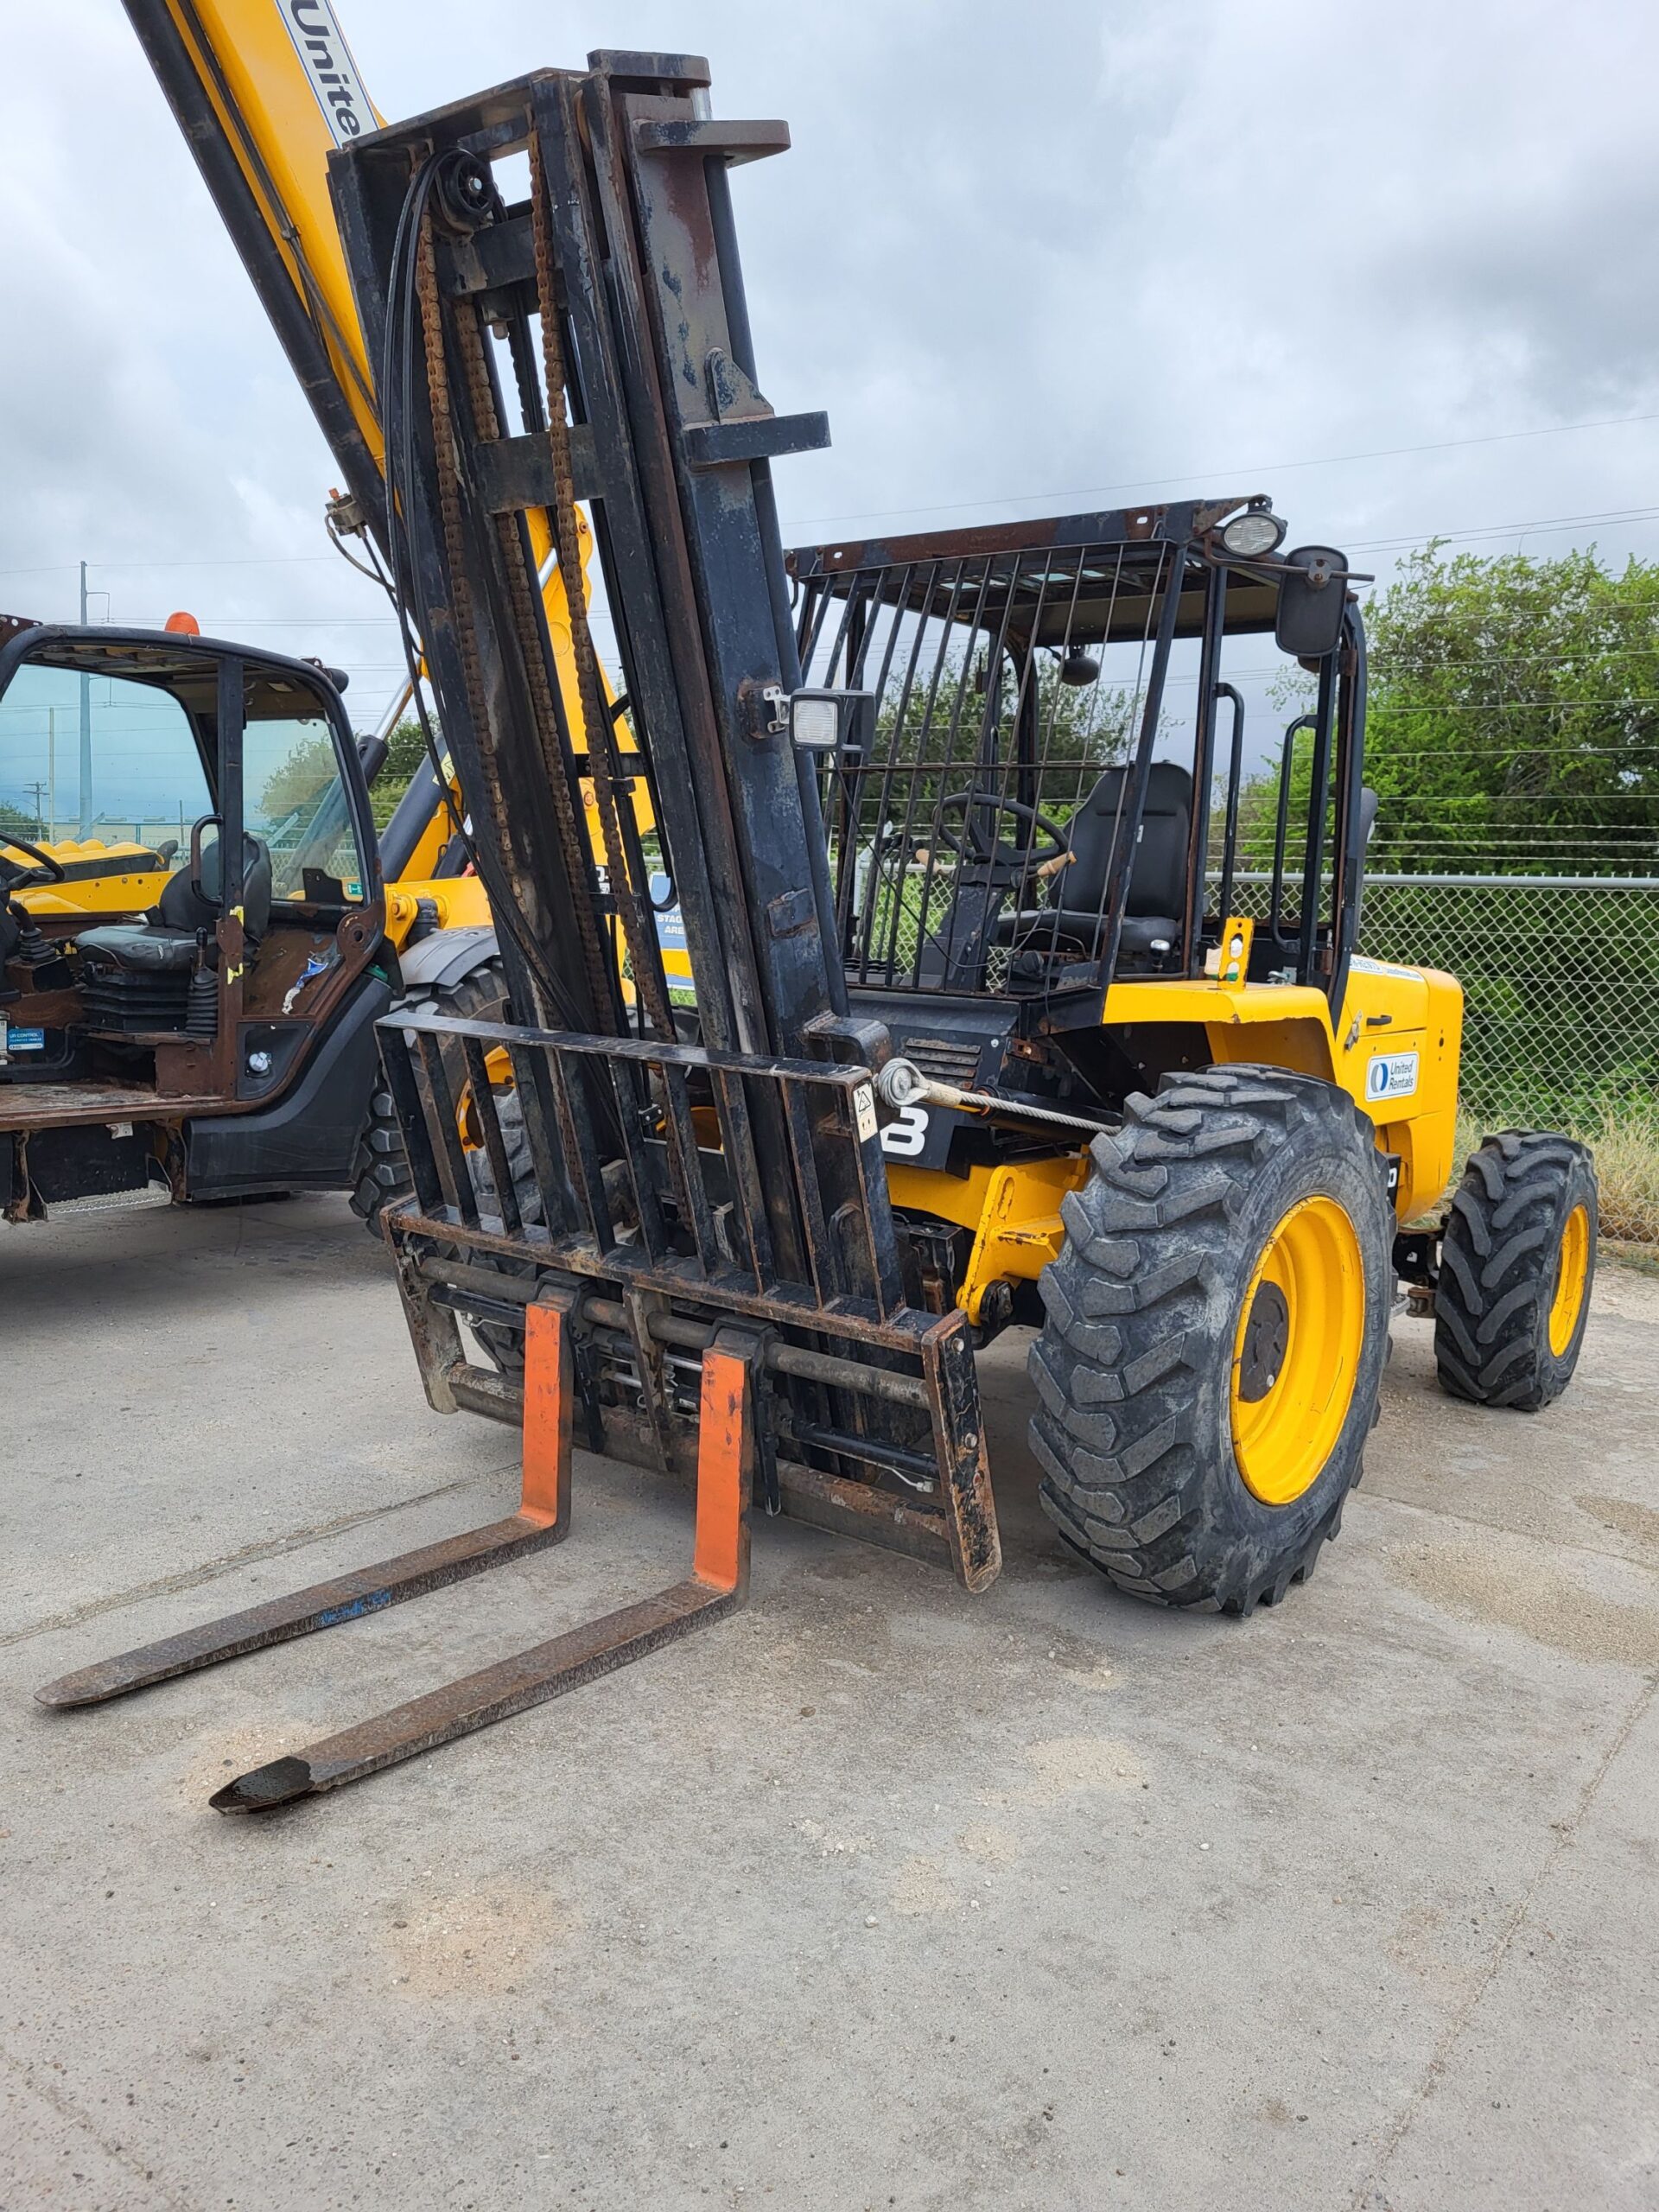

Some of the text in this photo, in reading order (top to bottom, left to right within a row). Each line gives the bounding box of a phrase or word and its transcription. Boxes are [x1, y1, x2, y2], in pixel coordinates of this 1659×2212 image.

[290, 0, 361, 137] Unite
[657, 914, 683, 924] STAG
[664, 925, 684, 935] ARE
[1390, 1059, 1414, 1075] United
[1388, 1075, 1414, 1090] Rentals
